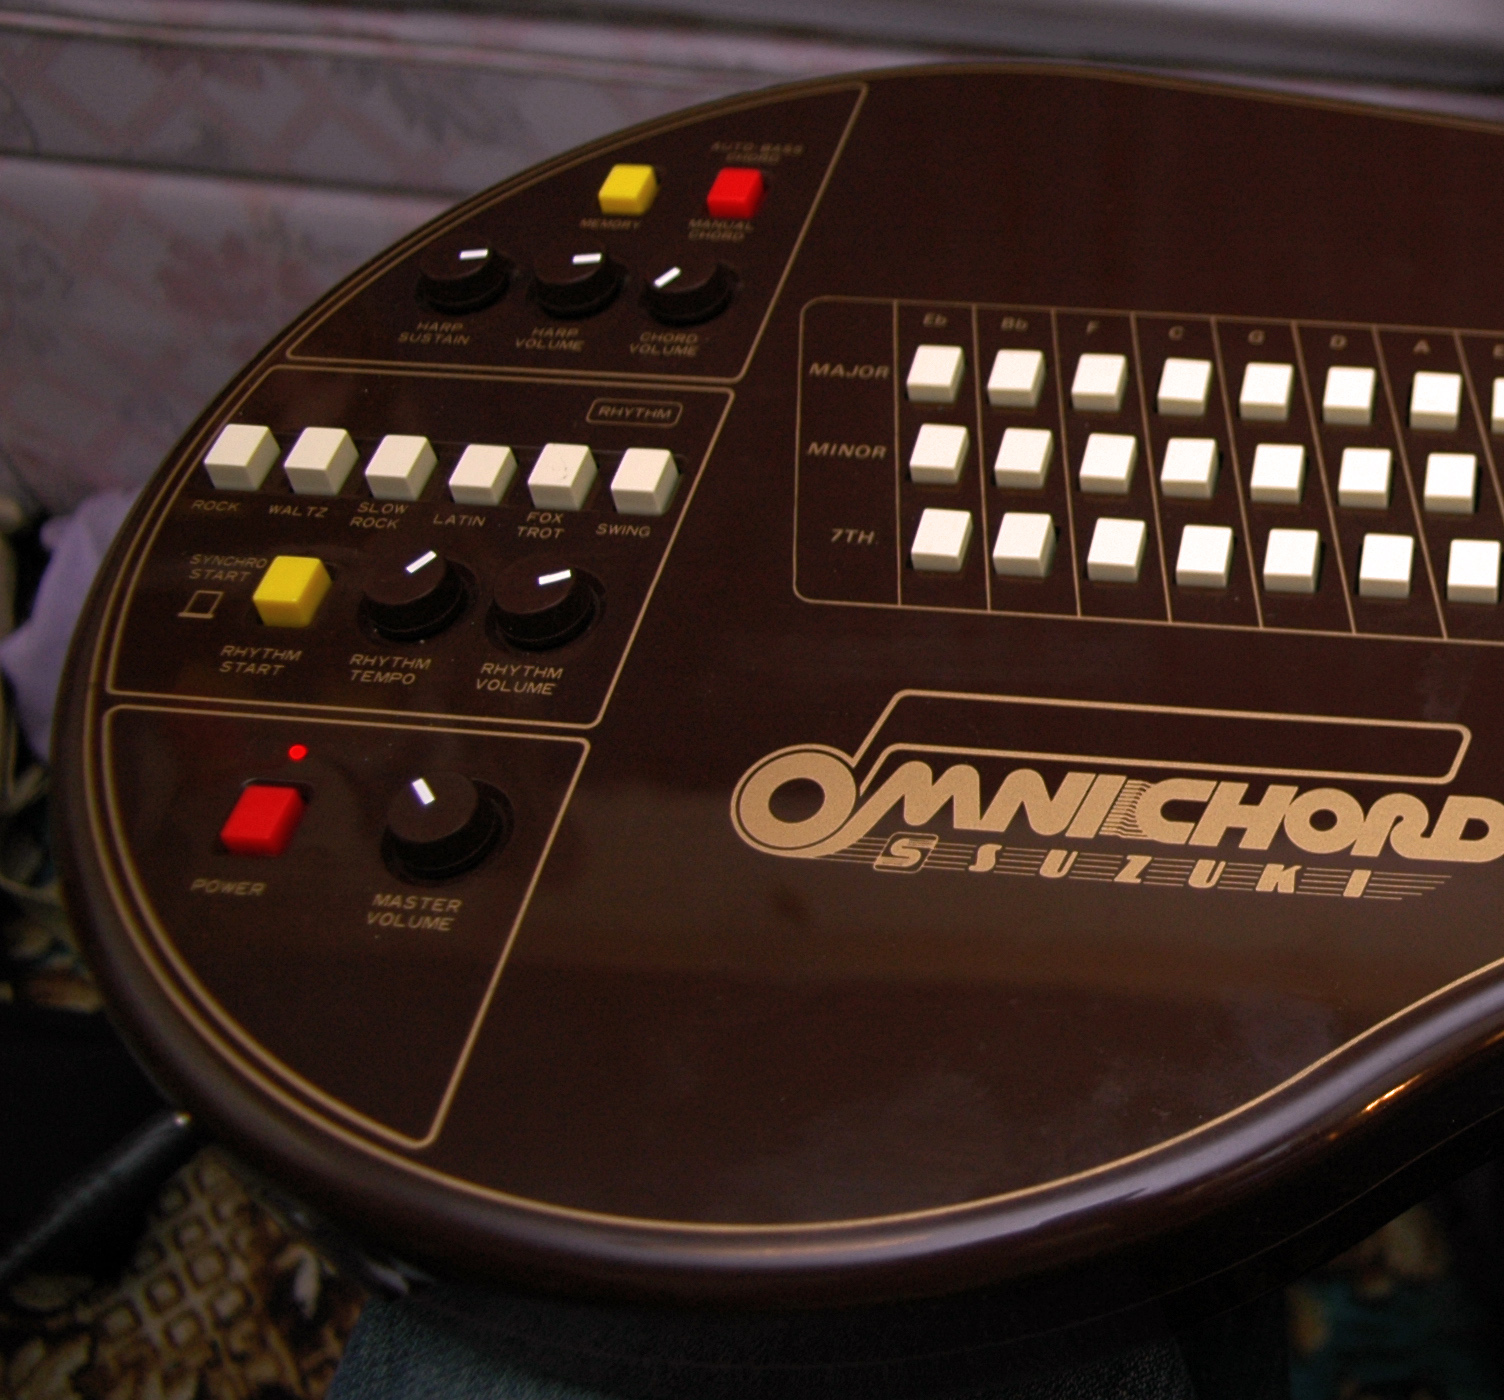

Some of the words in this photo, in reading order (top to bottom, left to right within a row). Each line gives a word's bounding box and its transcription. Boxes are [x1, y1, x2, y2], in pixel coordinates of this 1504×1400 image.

[711, 142, 756, 153] AUTO
[579, 217, 641, 231] MEMORY
[688, 217, 754, 231] MANUAL
[688, 229, 745, 242] CHORD
[417, 321, 463, 333] HARP
[532, 326, 579, 339] HARP
[399, 332, 470, 345] SUSTAIN
[639, 331, 698, 344] CHORD
[1086, 320, 1099, 334] F
[1168, 325, 1185, 340] C
[1330, 334, 1347, 349] D
[1413, 339, 1430, 354] A
[515, 338, 585, 352] VOLUME
[629, 343, 698, 357] VOLUME
[809, 362, 890, 380] MAJOR
[598, 405, 673, 421] RHYTHM
[807, 441, 887, 460] MINOR
[192, 499, 240, 513] ROCK
[269, 505, 328, 518] WALTZ
[357, 501, 409, 515] SLOW
[349, 516, 400, 530] ROCK
[433, 513, 486, 527] LATIN
[526, 512, 564, 525] FOX
[517, 526, 564, 540] TROT
[596, 524, 651, 538] SWING
[190, 554, 267, 569] SYNCHRO
[189, 568, 252, 583] START
[221, 645, 302, 662] RHYTHM
[219, 661, 284, 676] START
[350, 654, 432, 670] RHYTHM
[350, 669, 416, 686] TEMPO
[481, 662, 563, 679] RHYTHM
[476, 678, 556, 695] VOLUME
[191, 878, 267, 897] POWER
[372, 893, 462, 913] MASTER
[366, 911, 454, 932] VOLUME
